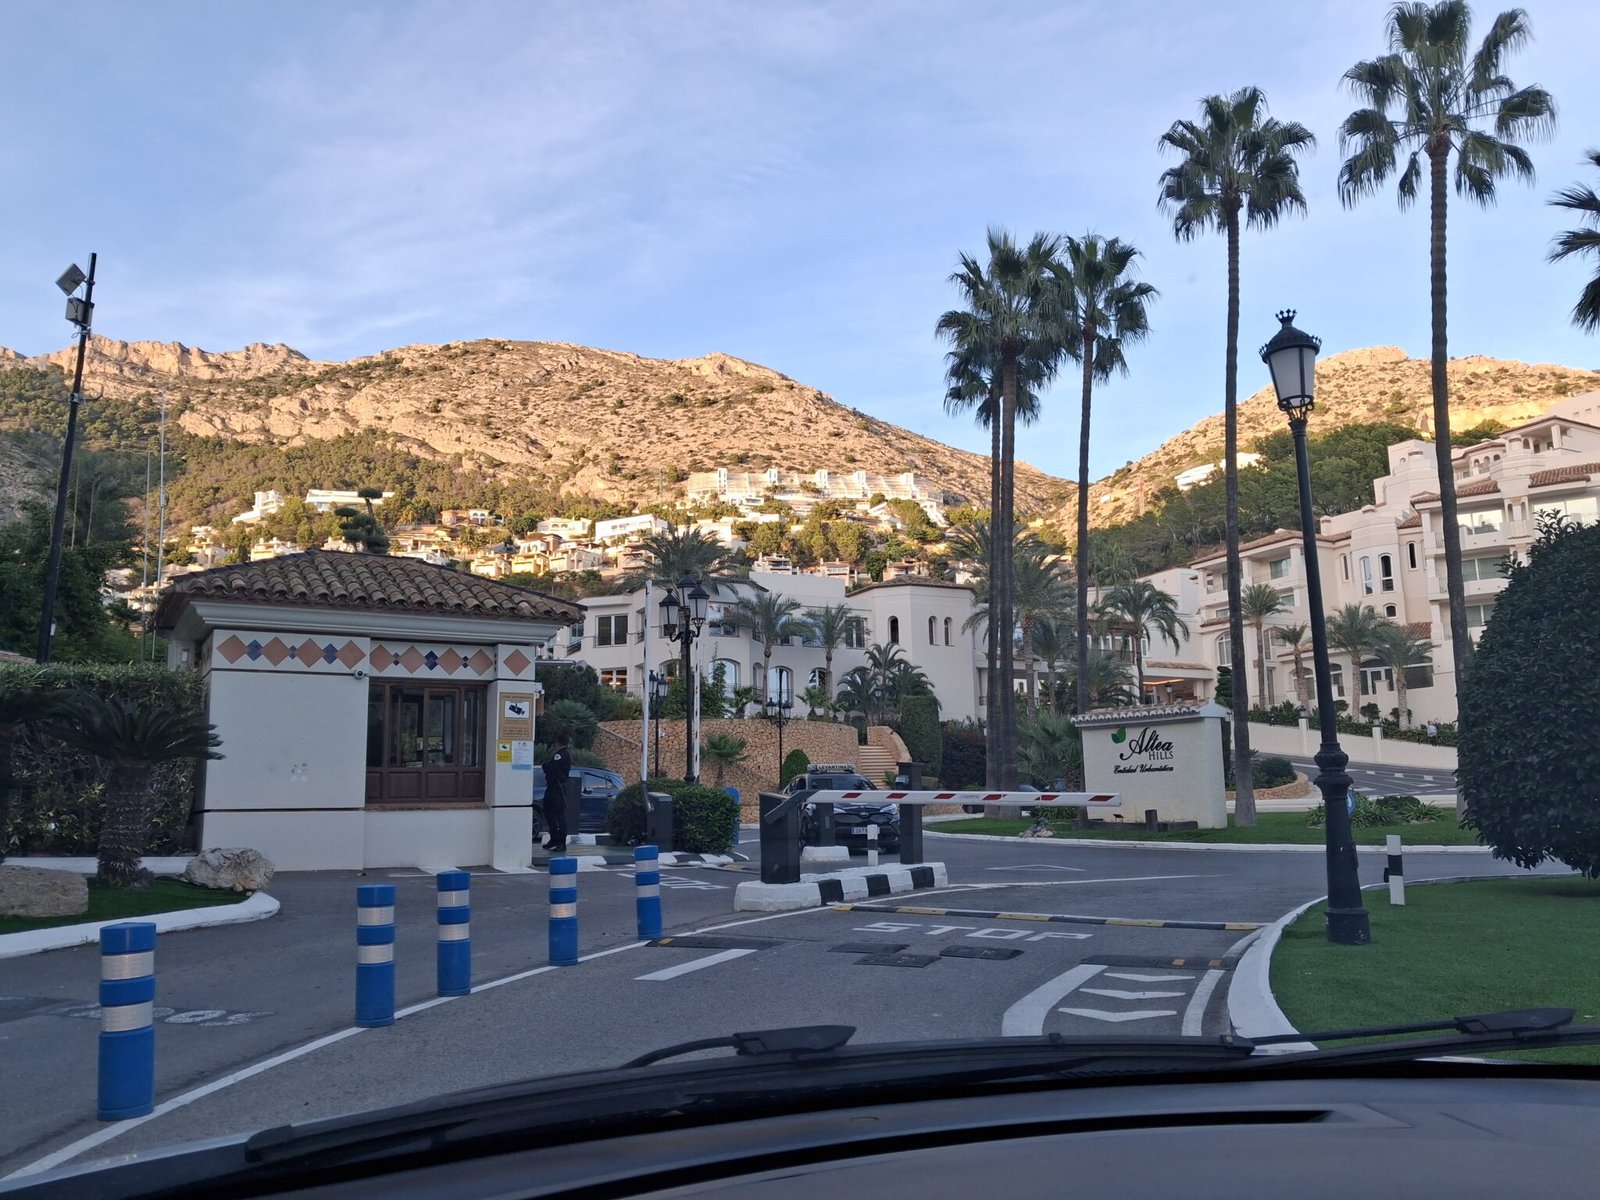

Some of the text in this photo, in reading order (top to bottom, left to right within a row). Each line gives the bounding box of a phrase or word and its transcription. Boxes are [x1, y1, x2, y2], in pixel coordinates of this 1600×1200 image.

[1119, 726, 1174, 761] Altea
[1148, 751, 1174, 760] HILLS
[1113, 764, 1139, 774] Entidad
[852, 921, 1094, 942] STOP
